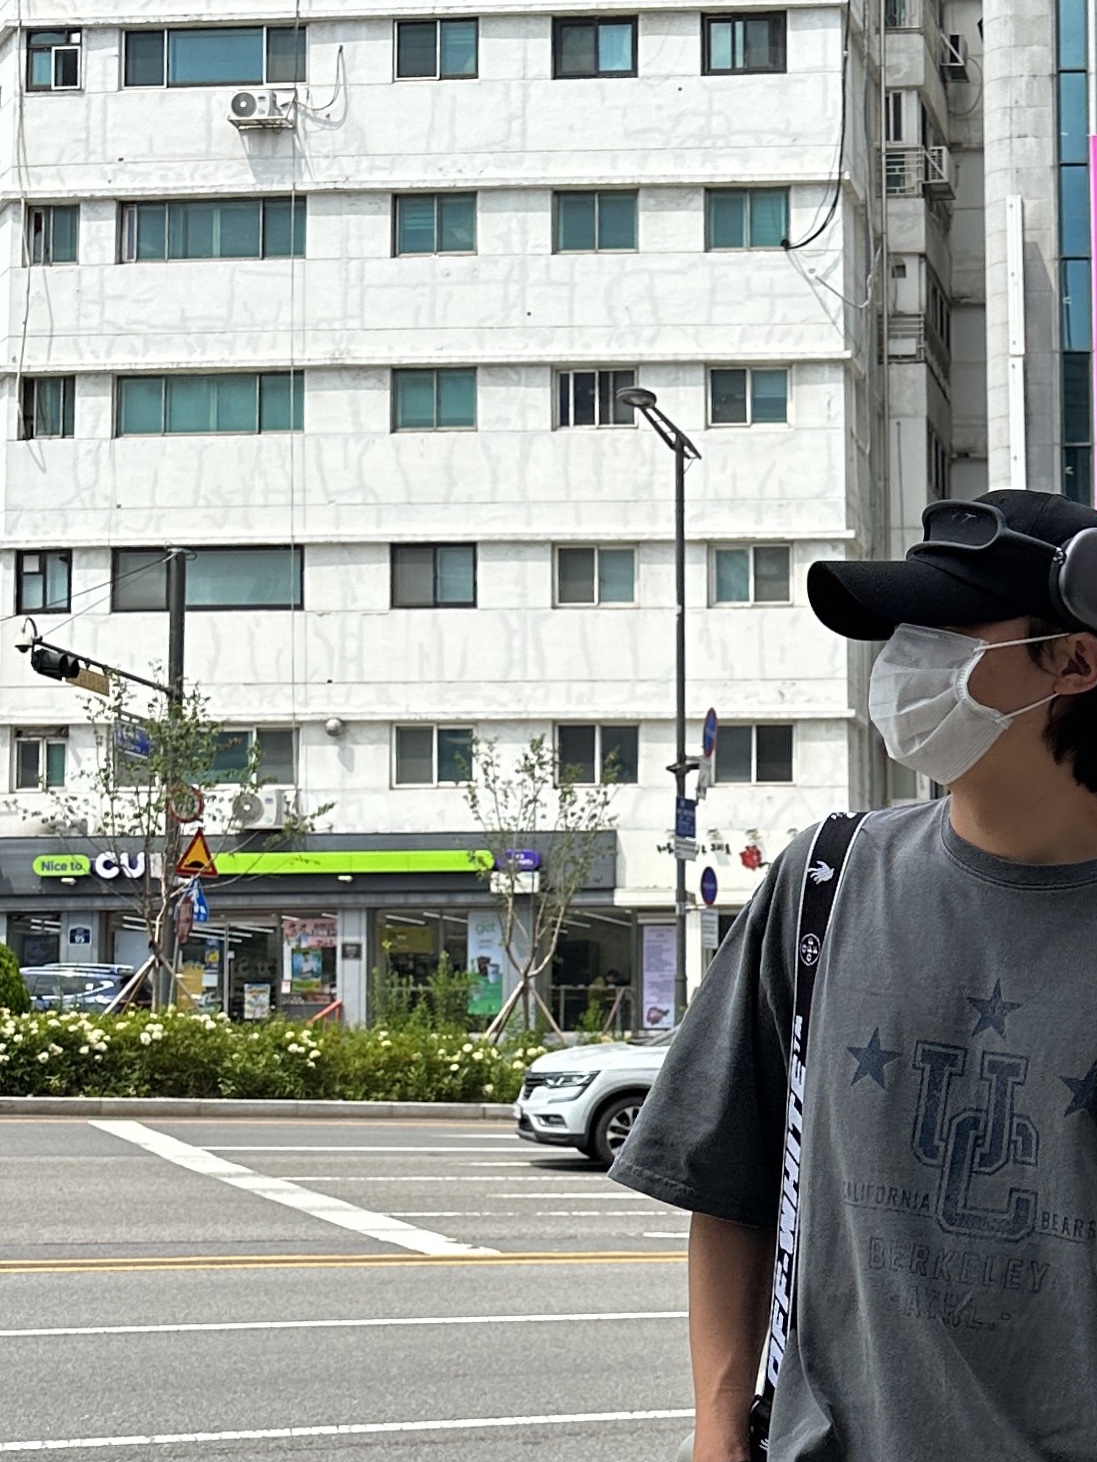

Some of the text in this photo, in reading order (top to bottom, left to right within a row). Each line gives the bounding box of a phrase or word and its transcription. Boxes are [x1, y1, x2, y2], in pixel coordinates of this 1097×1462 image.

[41, 851, 145, 879] Nice to CU
[1041, 1211, 1096, 1240] BEARS
[867, 1235, 1051, 1293] BERKELEY
